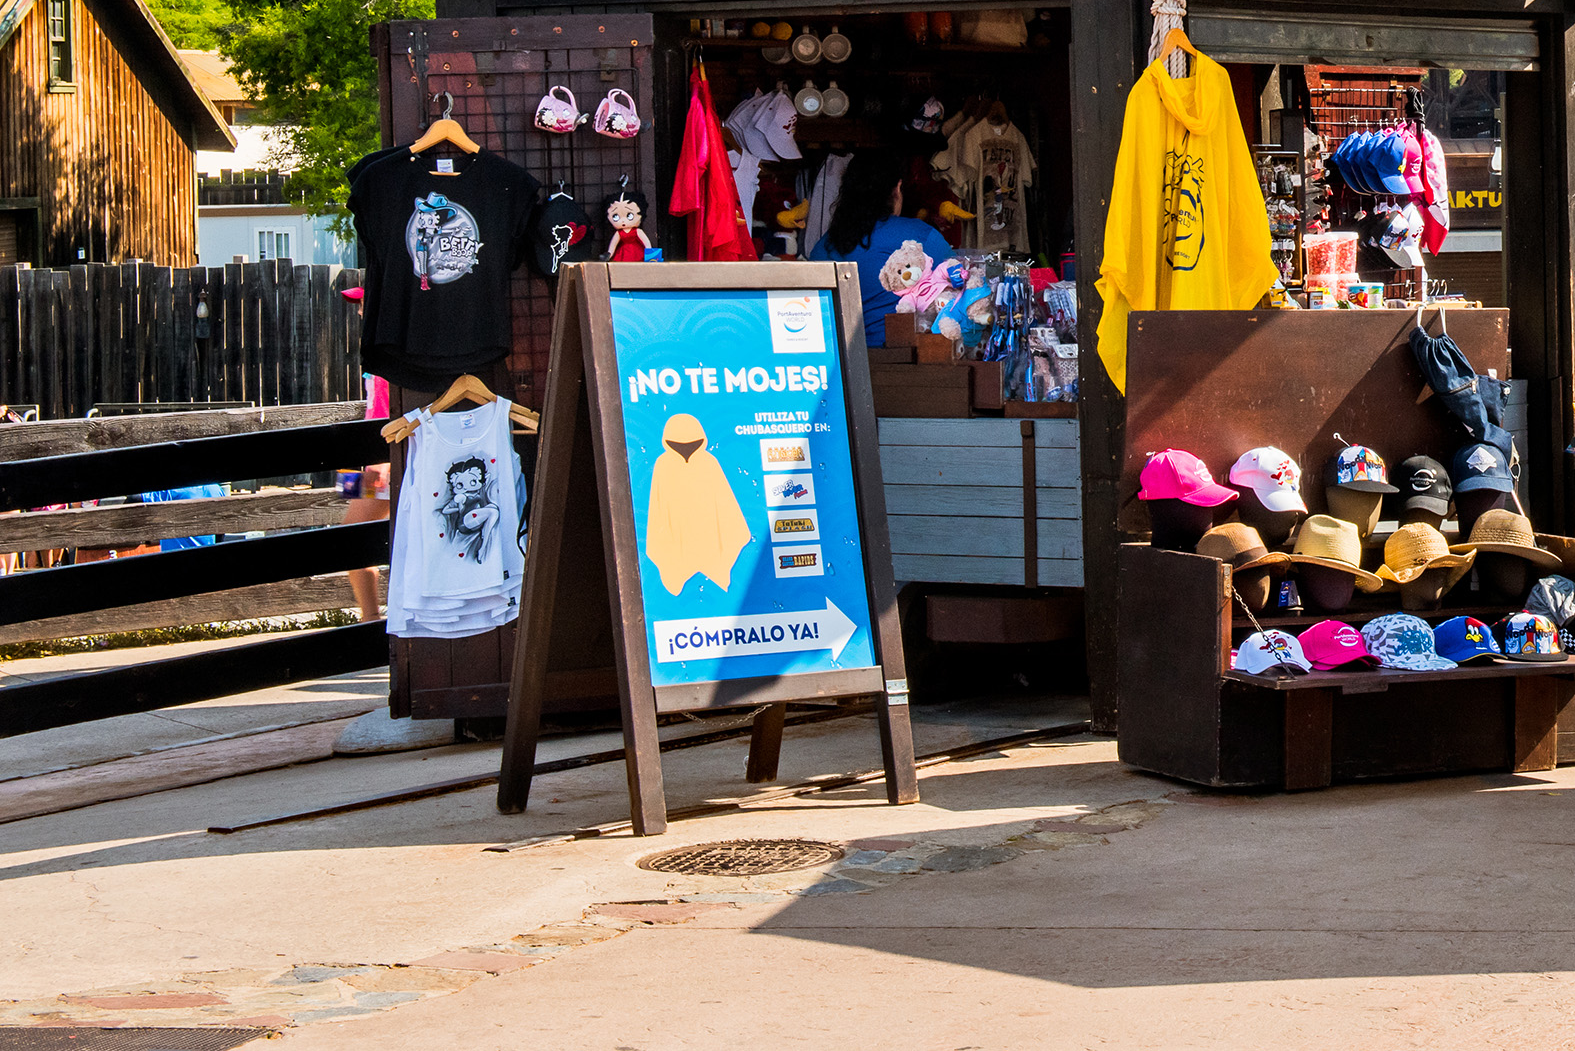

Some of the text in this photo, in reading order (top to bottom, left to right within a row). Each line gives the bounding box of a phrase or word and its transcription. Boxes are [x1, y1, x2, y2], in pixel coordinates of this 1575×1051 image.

[439, 235, 484, 254] BETTY
[628, 365, 828, 403] ¡NO TE MOJES!
[755, 411, 809, 422] UTILIZA TU
[735, 423, 831, 435] CHUBASQUERO EN:
[669, 622, 819, 655] ¡CÓMPRALO YA!
